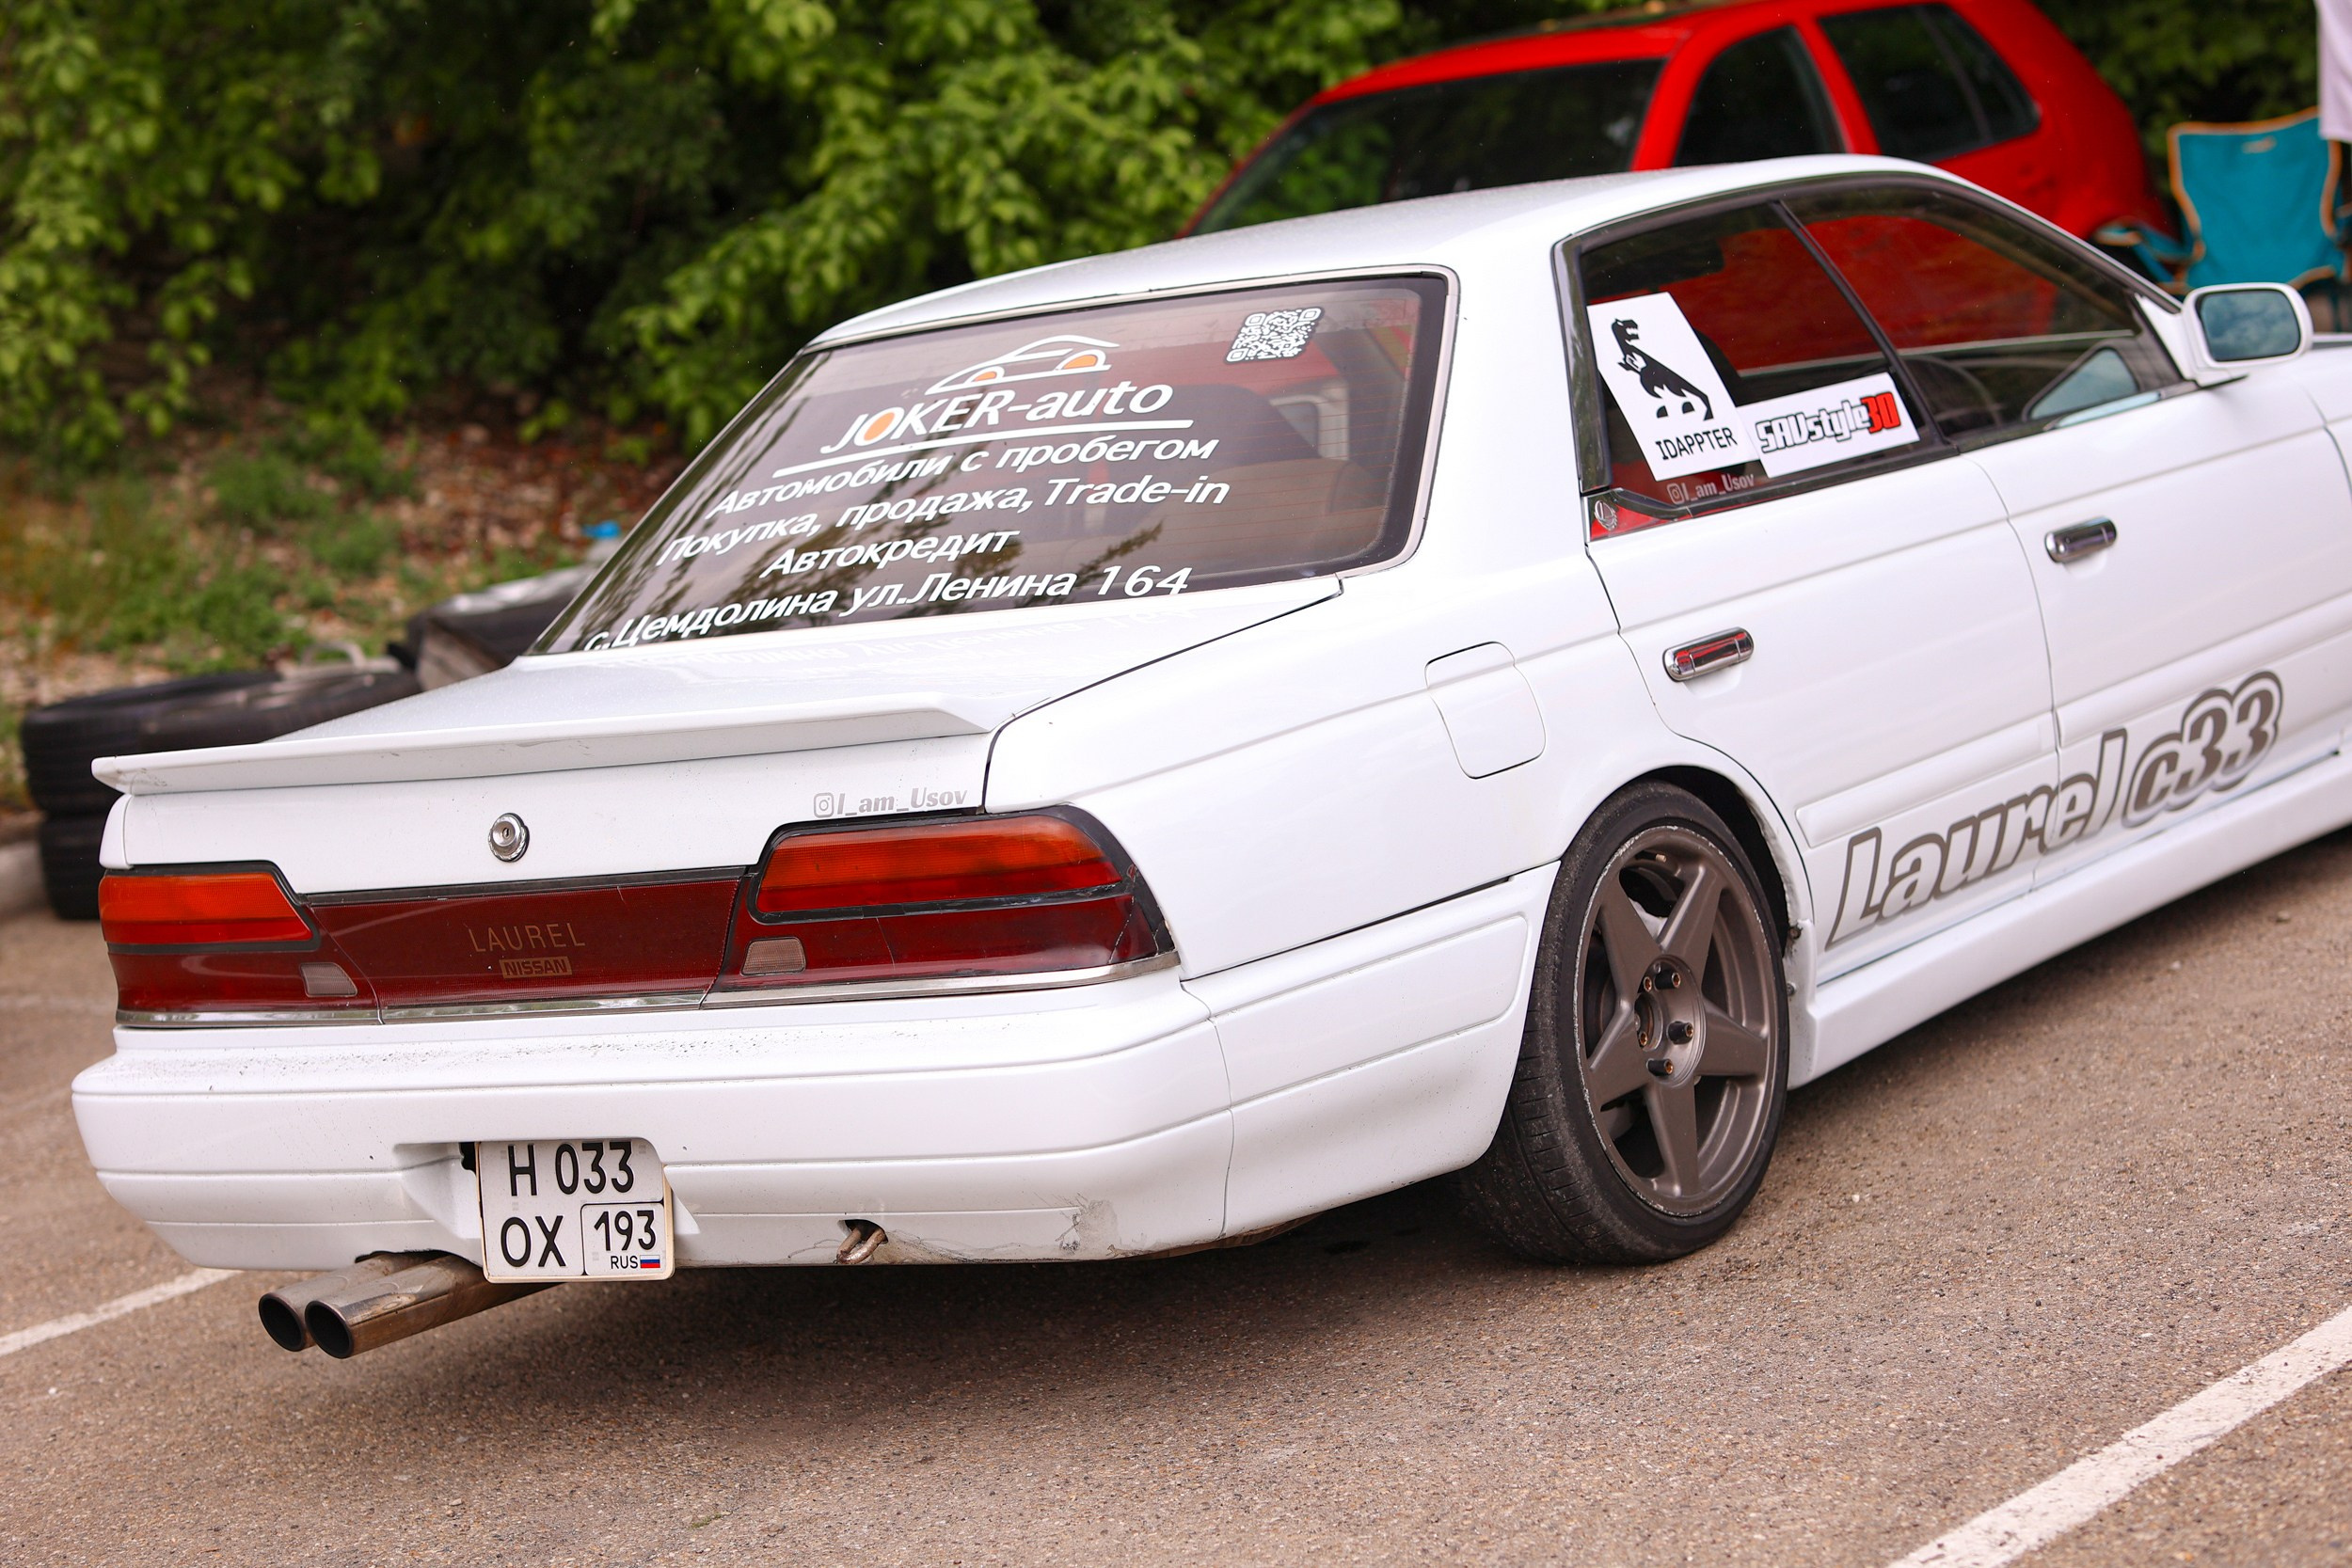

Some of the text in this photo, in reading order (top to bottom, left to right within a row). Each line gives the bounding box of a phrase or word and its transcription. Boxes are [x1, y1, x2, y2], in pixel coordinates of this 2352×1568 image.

[819, 380, 1174, 455] JOKER-auto
[1655, 427, 1738, 460] IDAPPTER
[704, 455, 952, 519] Автомобили
[995, 435, 1220, 473] пробегом
[656, 474, 1231, 566] Покупка, продажа, Trade-in
[758, 530, 1021, 579] Автокредит
[584, 589, 838, 652] с.Цемдолина
[839, 572, 1078, 618] ул.Ленина
[1097, 565, 1193, 597] 164
[1824, 727, 2128, 951] Laurel
[469, 922, 585, 953] LAUREL
[503, 959, 568, 976] NISSAN
[555, 1141, 635, 1196] 033
[594, 1210, 657, 1252] 193
[611, 1255, 638, 1269] RUS
